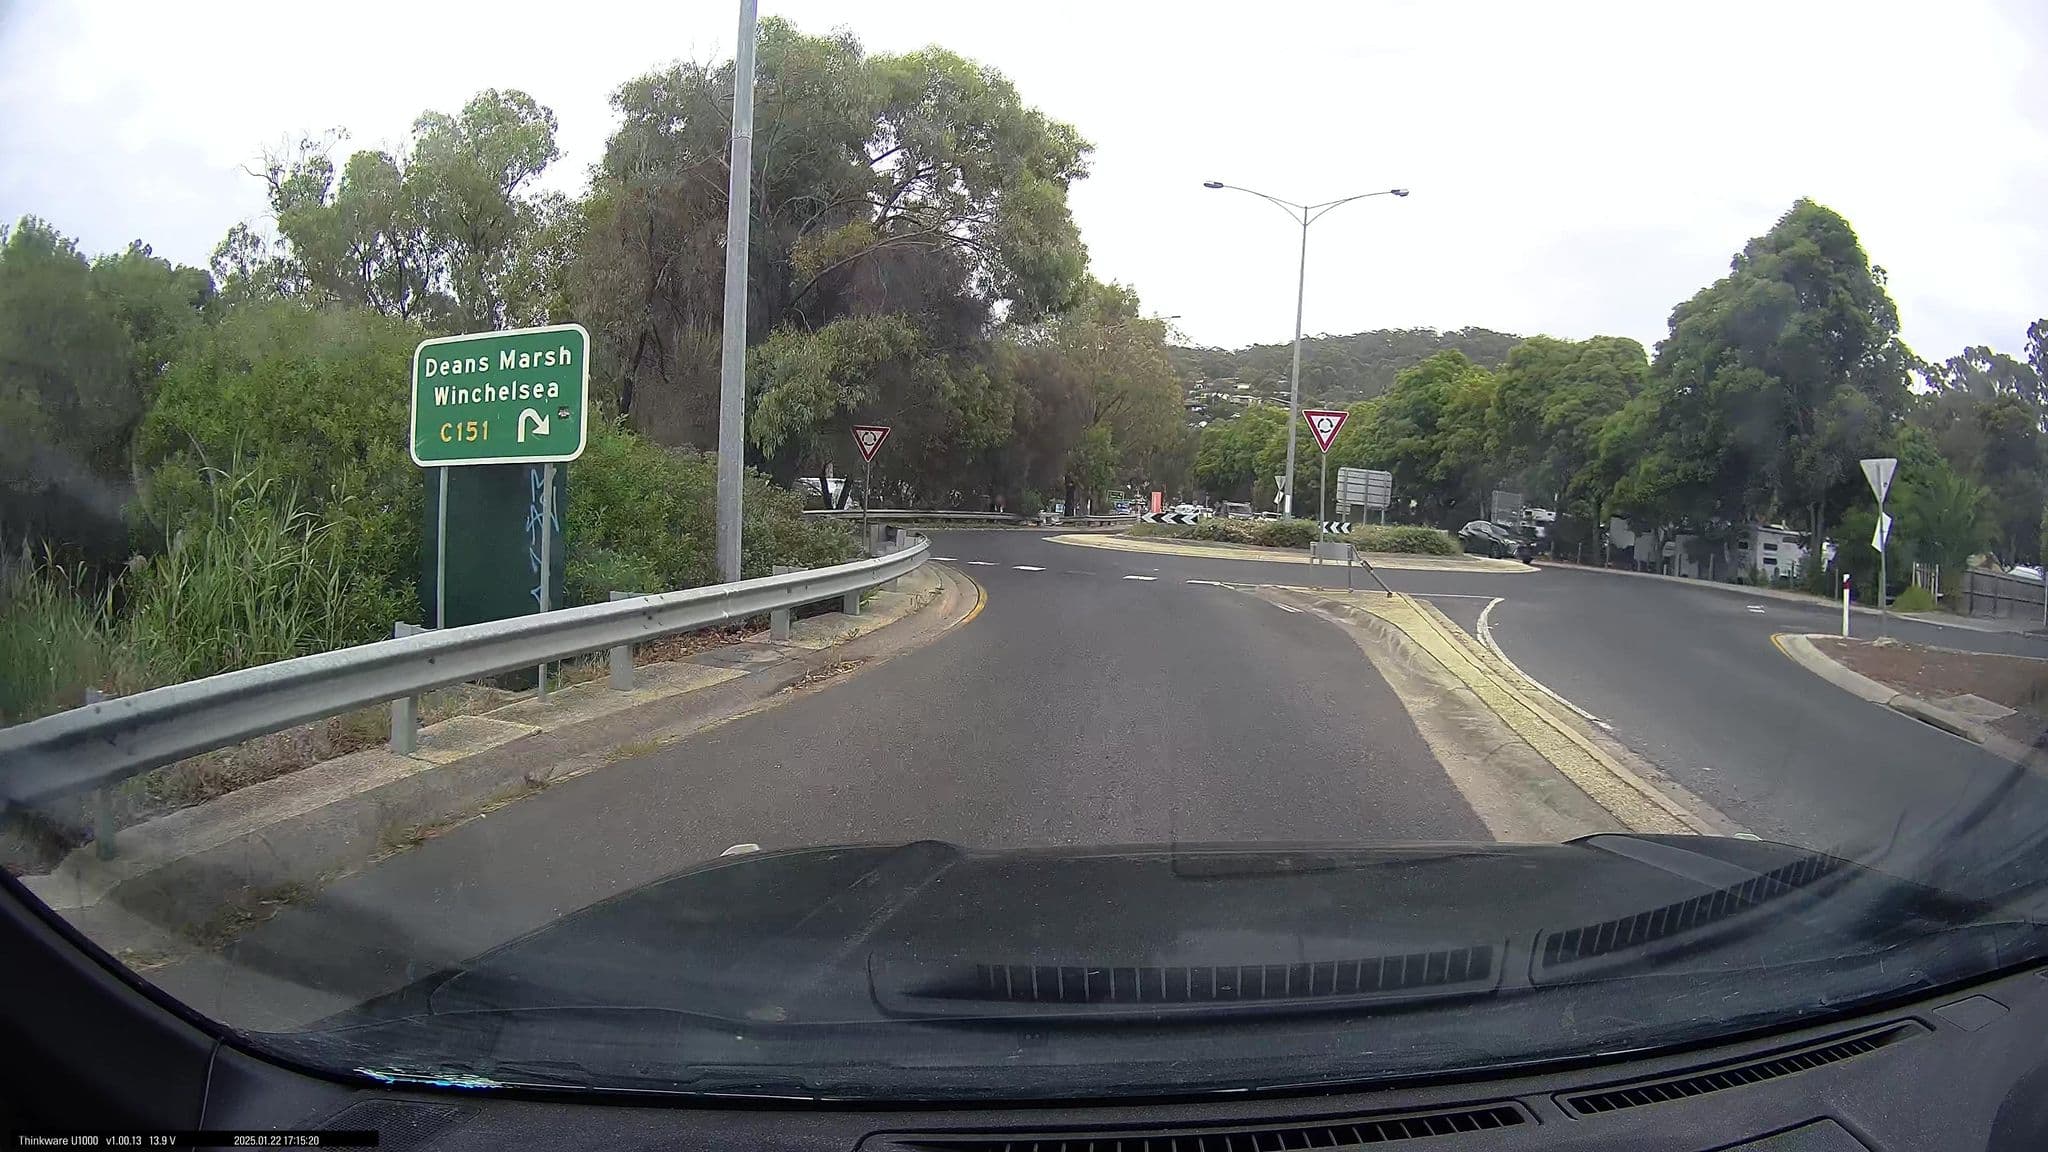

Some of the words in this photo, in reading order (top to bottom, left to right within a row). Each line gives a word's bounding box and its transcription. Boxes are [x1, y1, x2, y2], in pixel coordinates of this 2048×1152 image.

[425, 356, 489, 377] Deans
[500, 346, 571, 370] Marsh
[434, 380, 559, 406] Winchelsea
[440, 420, 488, 442] C151
